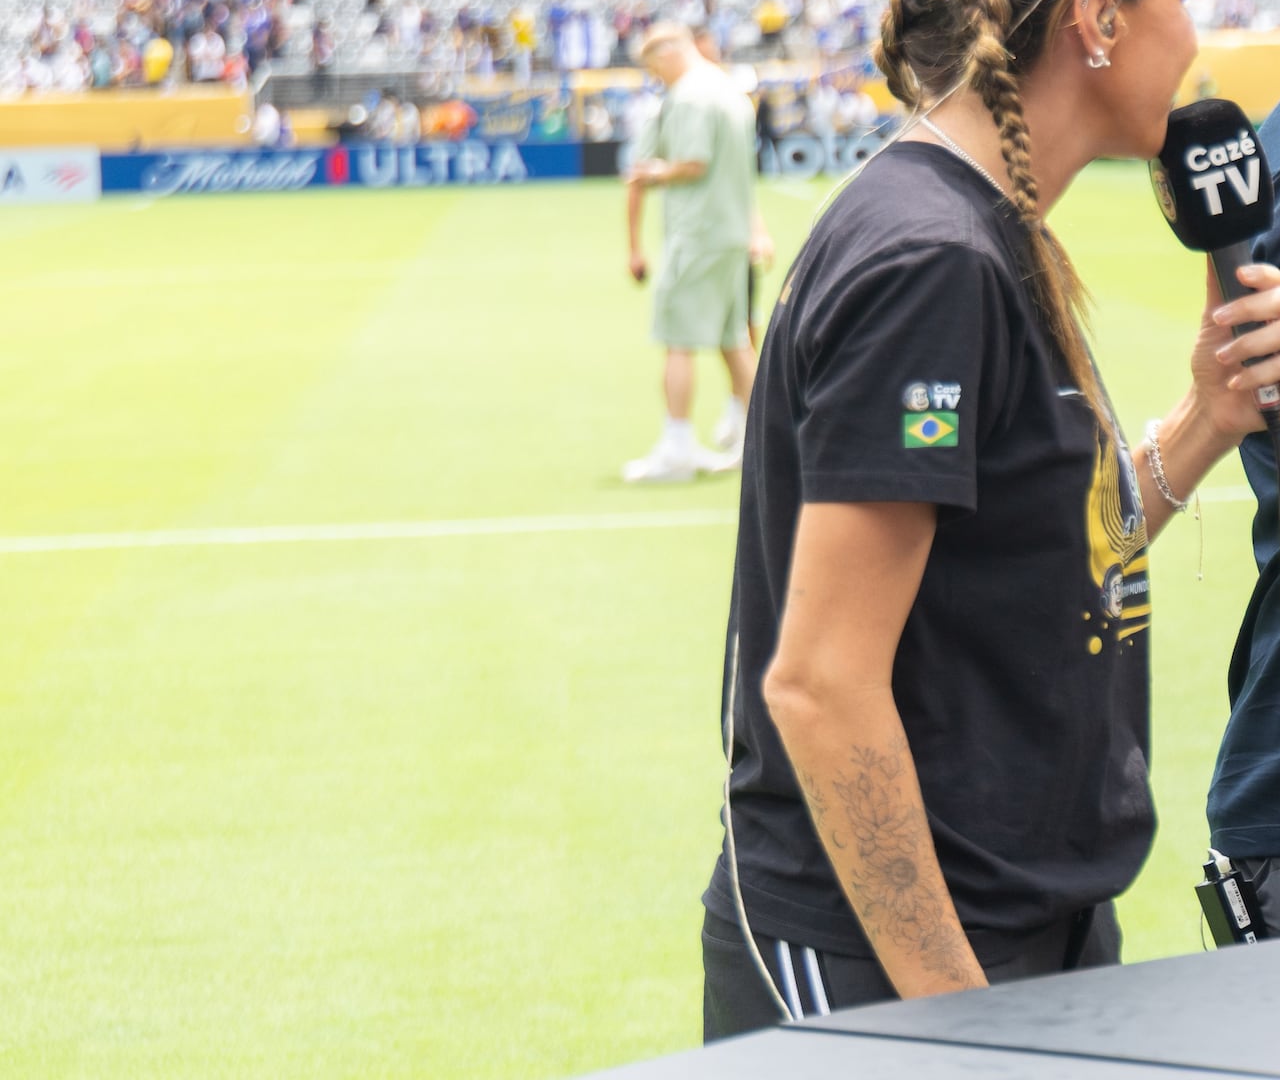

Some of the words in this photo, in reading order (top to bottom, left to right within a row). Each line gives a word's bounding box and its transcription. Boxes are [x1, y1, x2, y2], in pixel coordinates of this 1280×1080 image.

[357, 138, 529, 187] ULTRA
[1186, 130, 1257, 172] Cazé
[1193, 157, 1261, 216] TV
[933, 394, 962, 410] TV
